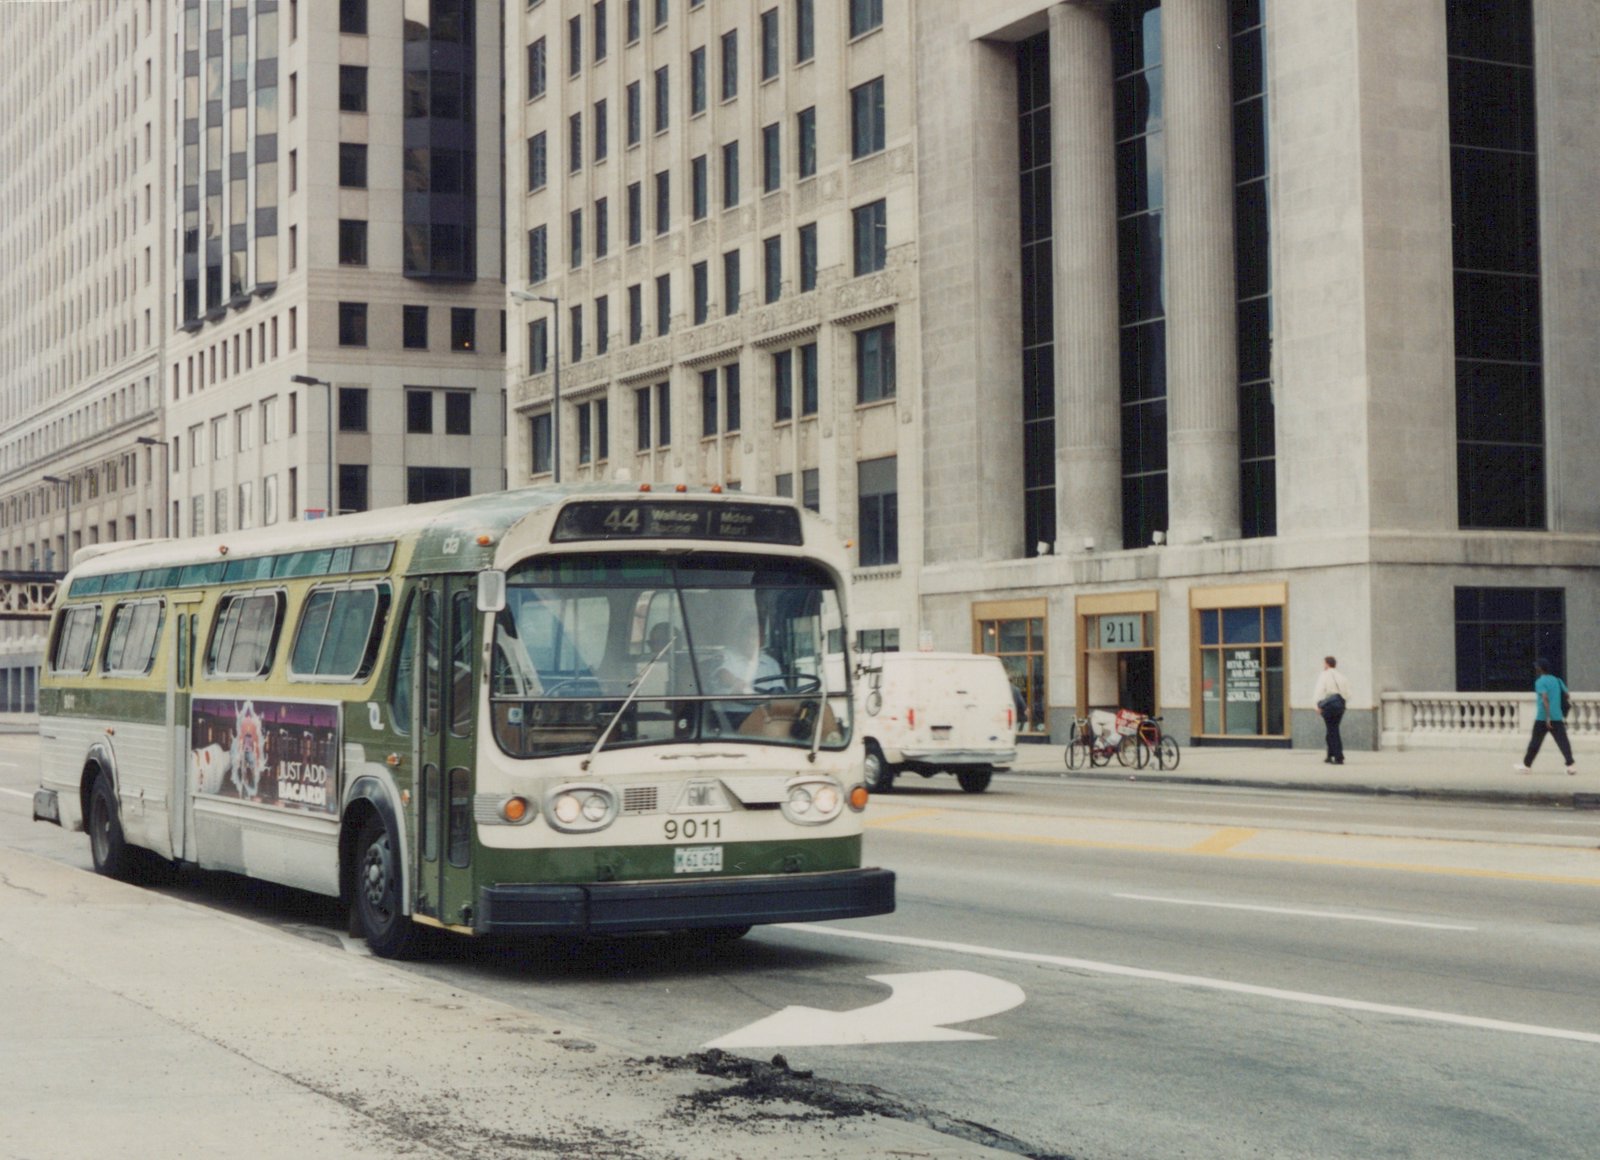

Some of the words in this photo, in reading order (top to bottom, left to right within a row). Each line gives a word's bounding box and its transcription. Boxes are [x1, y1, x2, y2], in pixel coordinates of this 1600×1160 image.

[603, 508, 641, 532] 44
[651, 509, 699, 522] Wallace
[720, 511, 754, 523] Mdse
[1106, 621, 1134, 643] 211
[278, 760, 302, 780] JUST
[303, 762, 327, 784] ADD
[278, 781, 327, 806] BACARDI
[664, 818, 721, 840] 9011
